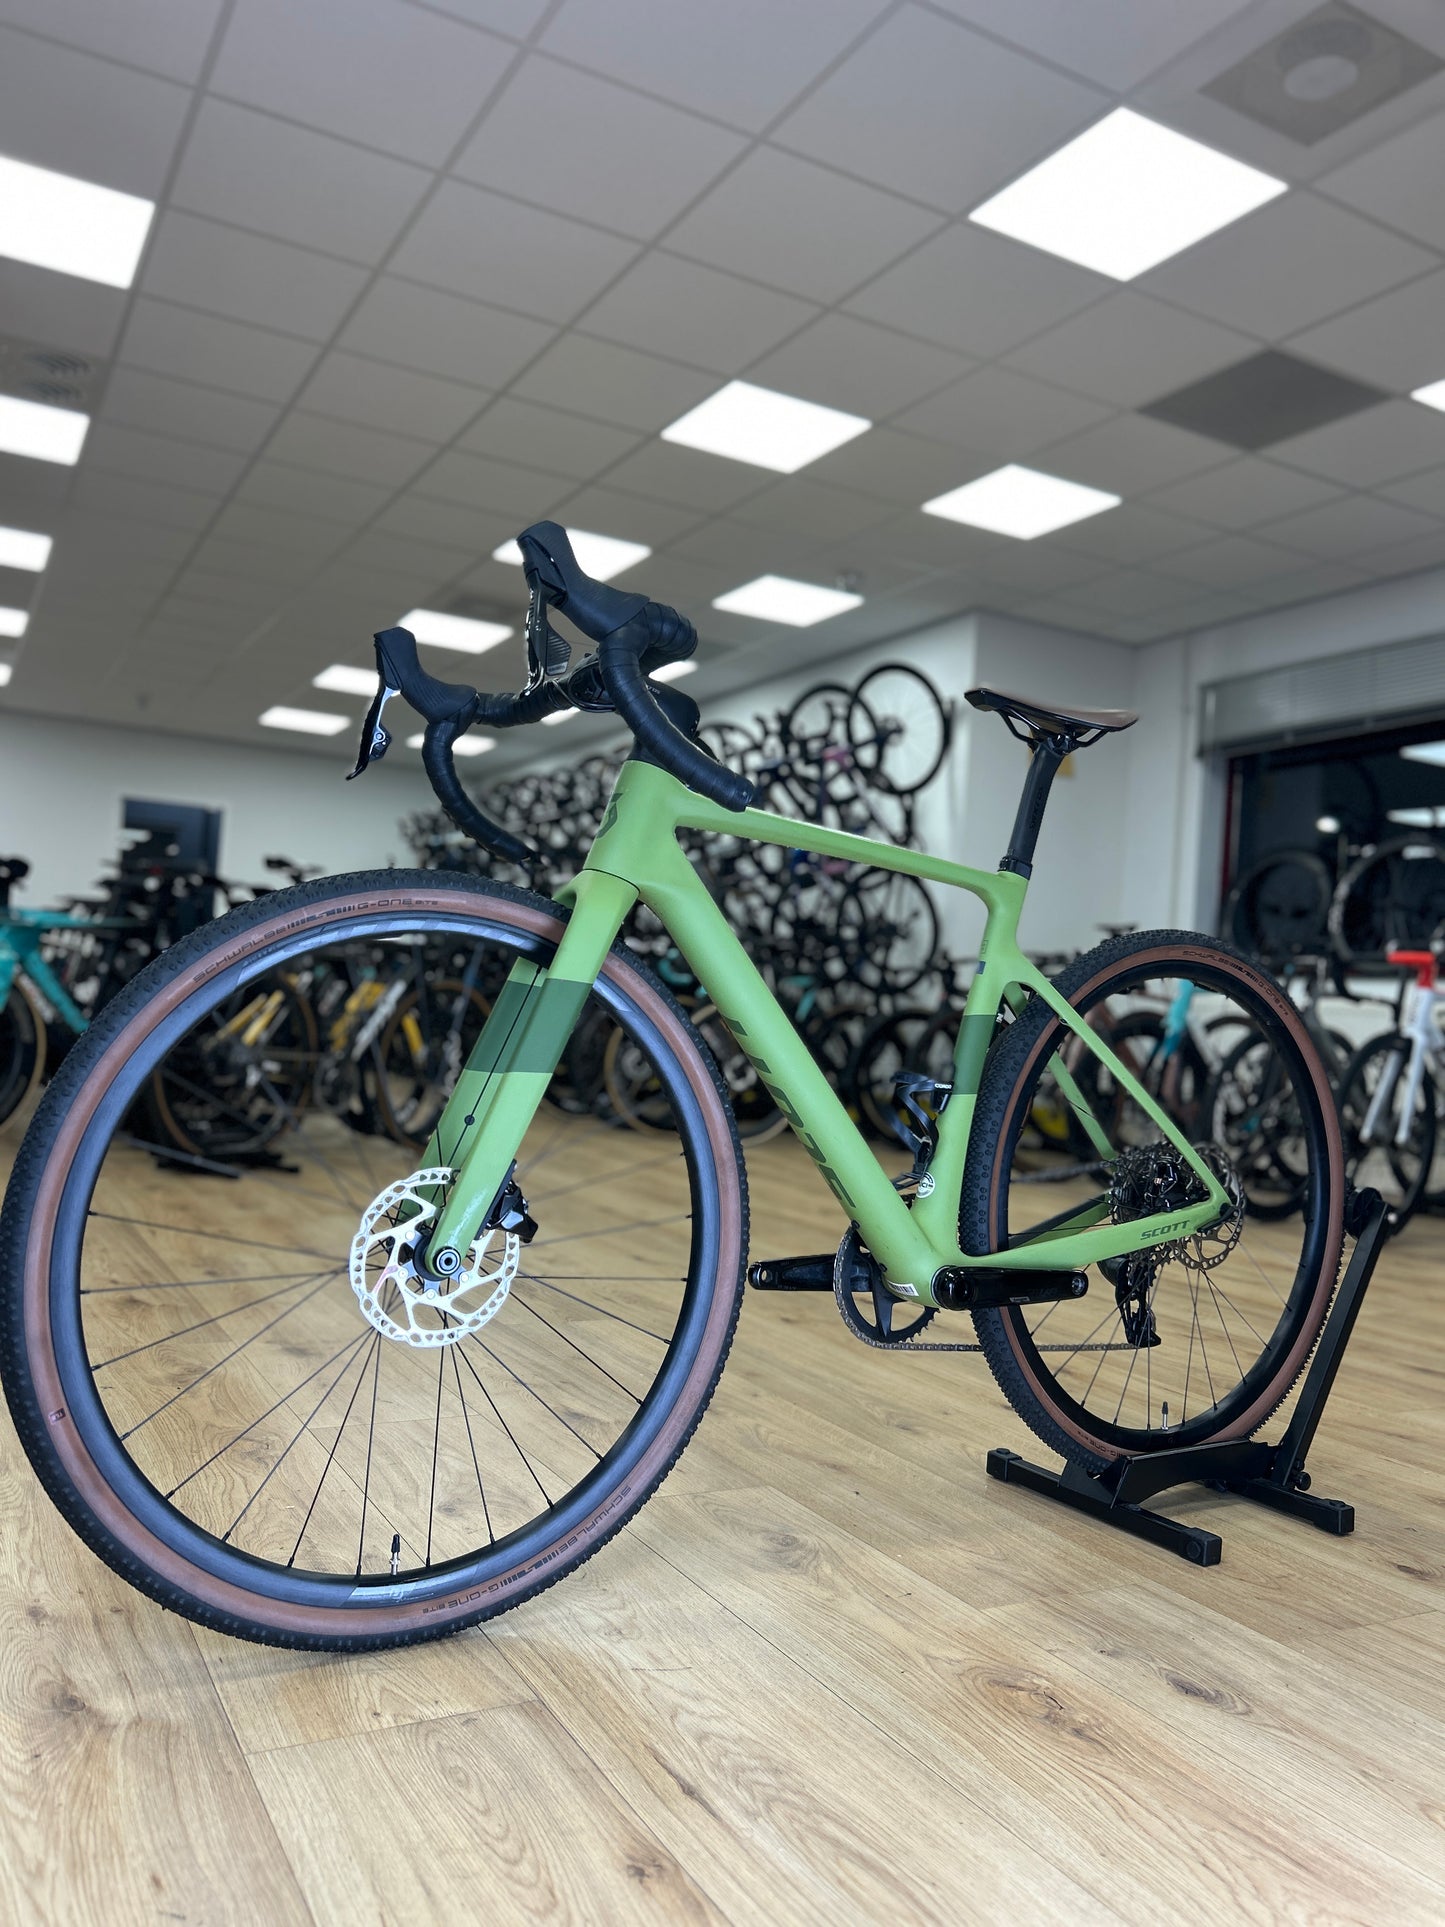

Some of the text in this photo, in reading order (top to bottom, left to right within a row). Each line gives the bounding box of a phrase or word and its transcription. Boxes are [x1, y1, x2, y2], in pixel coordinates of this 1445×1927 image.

[193, 928, 286, 983] SCHWALBE
[358, 898, 412, 910] G-ONE
[1140, 1220, 1190, 1240] SCOTT
[422, 1485, 632, 1614] SCHWALBE G-ONE BITE
